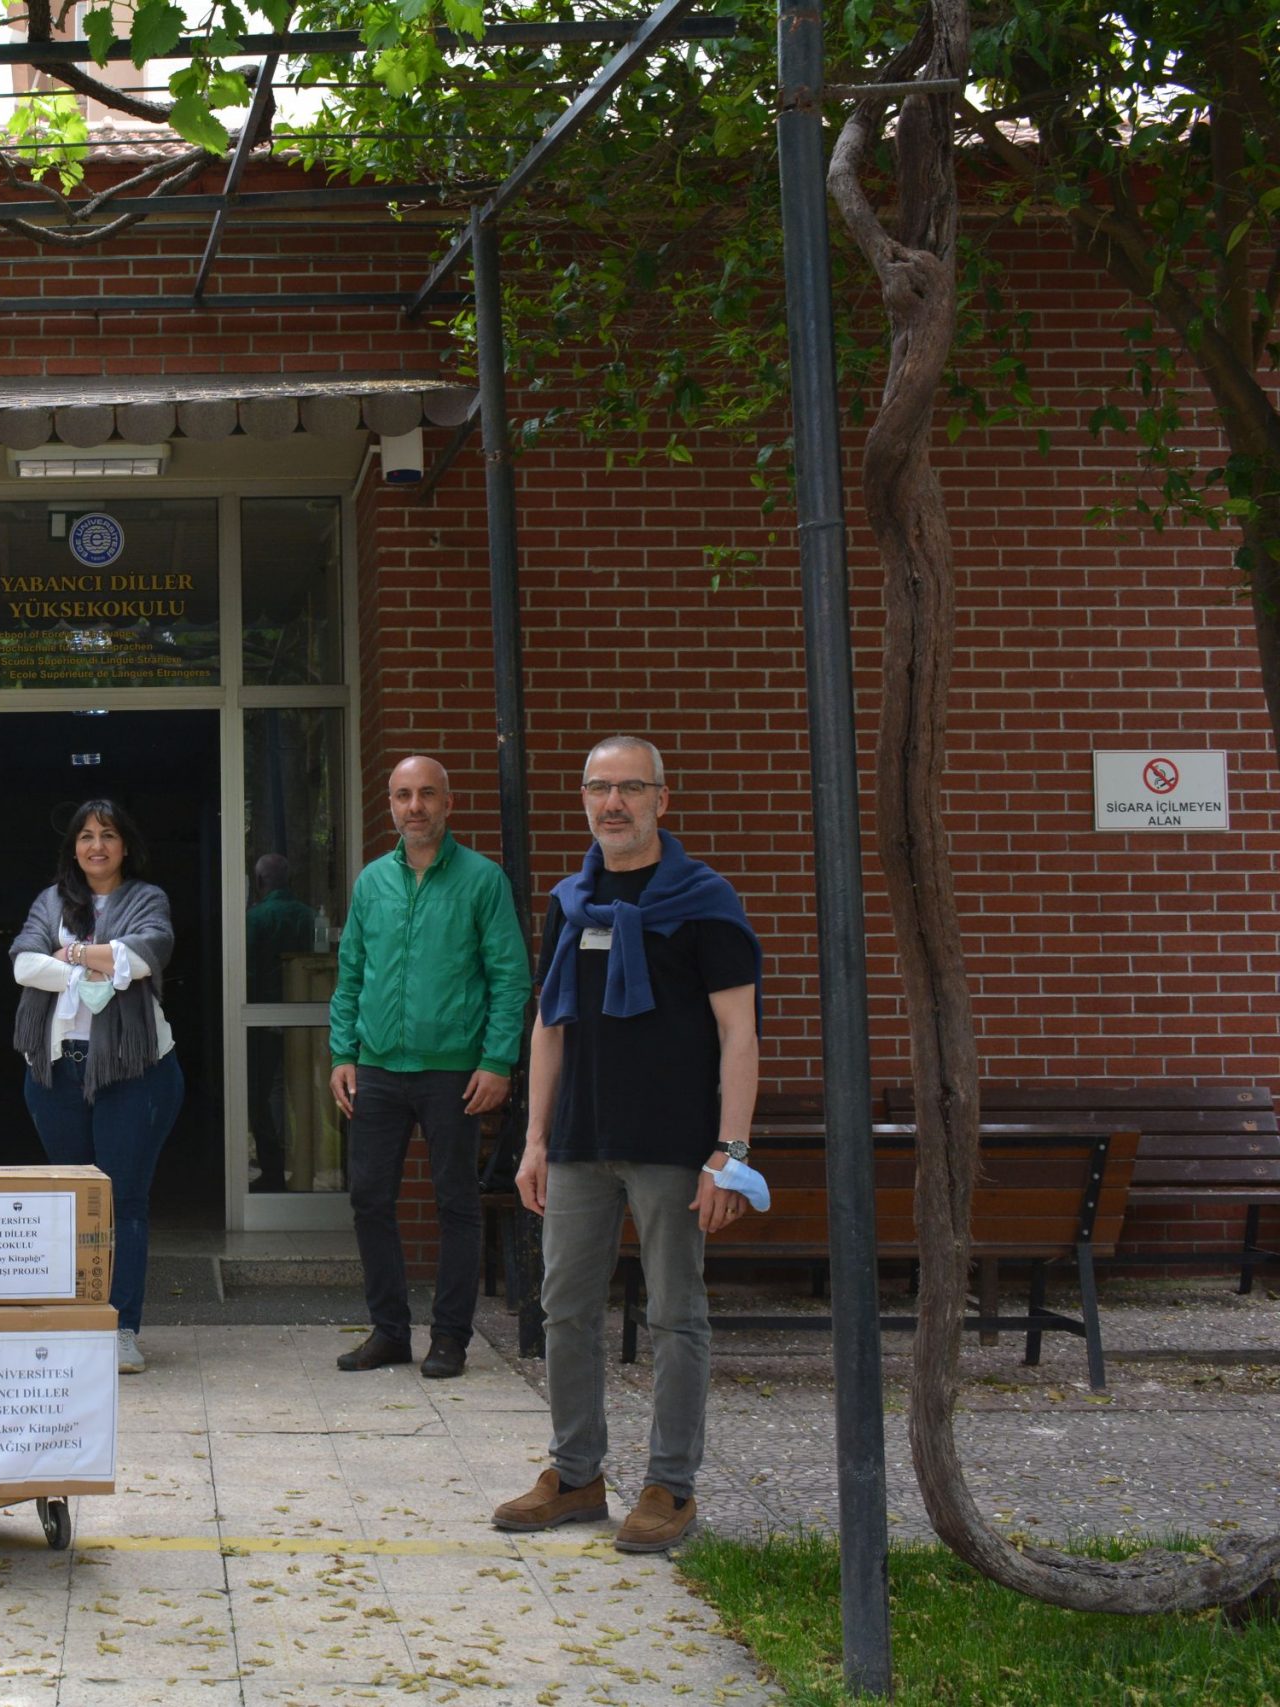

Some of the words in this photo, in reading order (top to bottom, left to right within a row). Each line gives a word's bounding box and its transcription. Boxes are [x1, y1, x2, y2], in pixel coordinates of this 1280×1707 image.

[0, 575, 102, 592] YABANCI
[111, 571, 195, 591] DİLLER
[8, 598, 185, 618] YÜKSEKOKULU
[0, 656, 35, 666] Scuola
[1106, 800, 1154, 813] SİGARA
[1156, 799, 1221, 815] İÇİLMEYEN
[1148, 816, 1181, 826] ALAN
[4, 1229, 38, 1238] DİLLER
[12, 1267, 49, 1275] PROJESİ
[23, 1386, 70, 1398] DİLLER
[34, 1439, 82, 1452] PROJESİ
